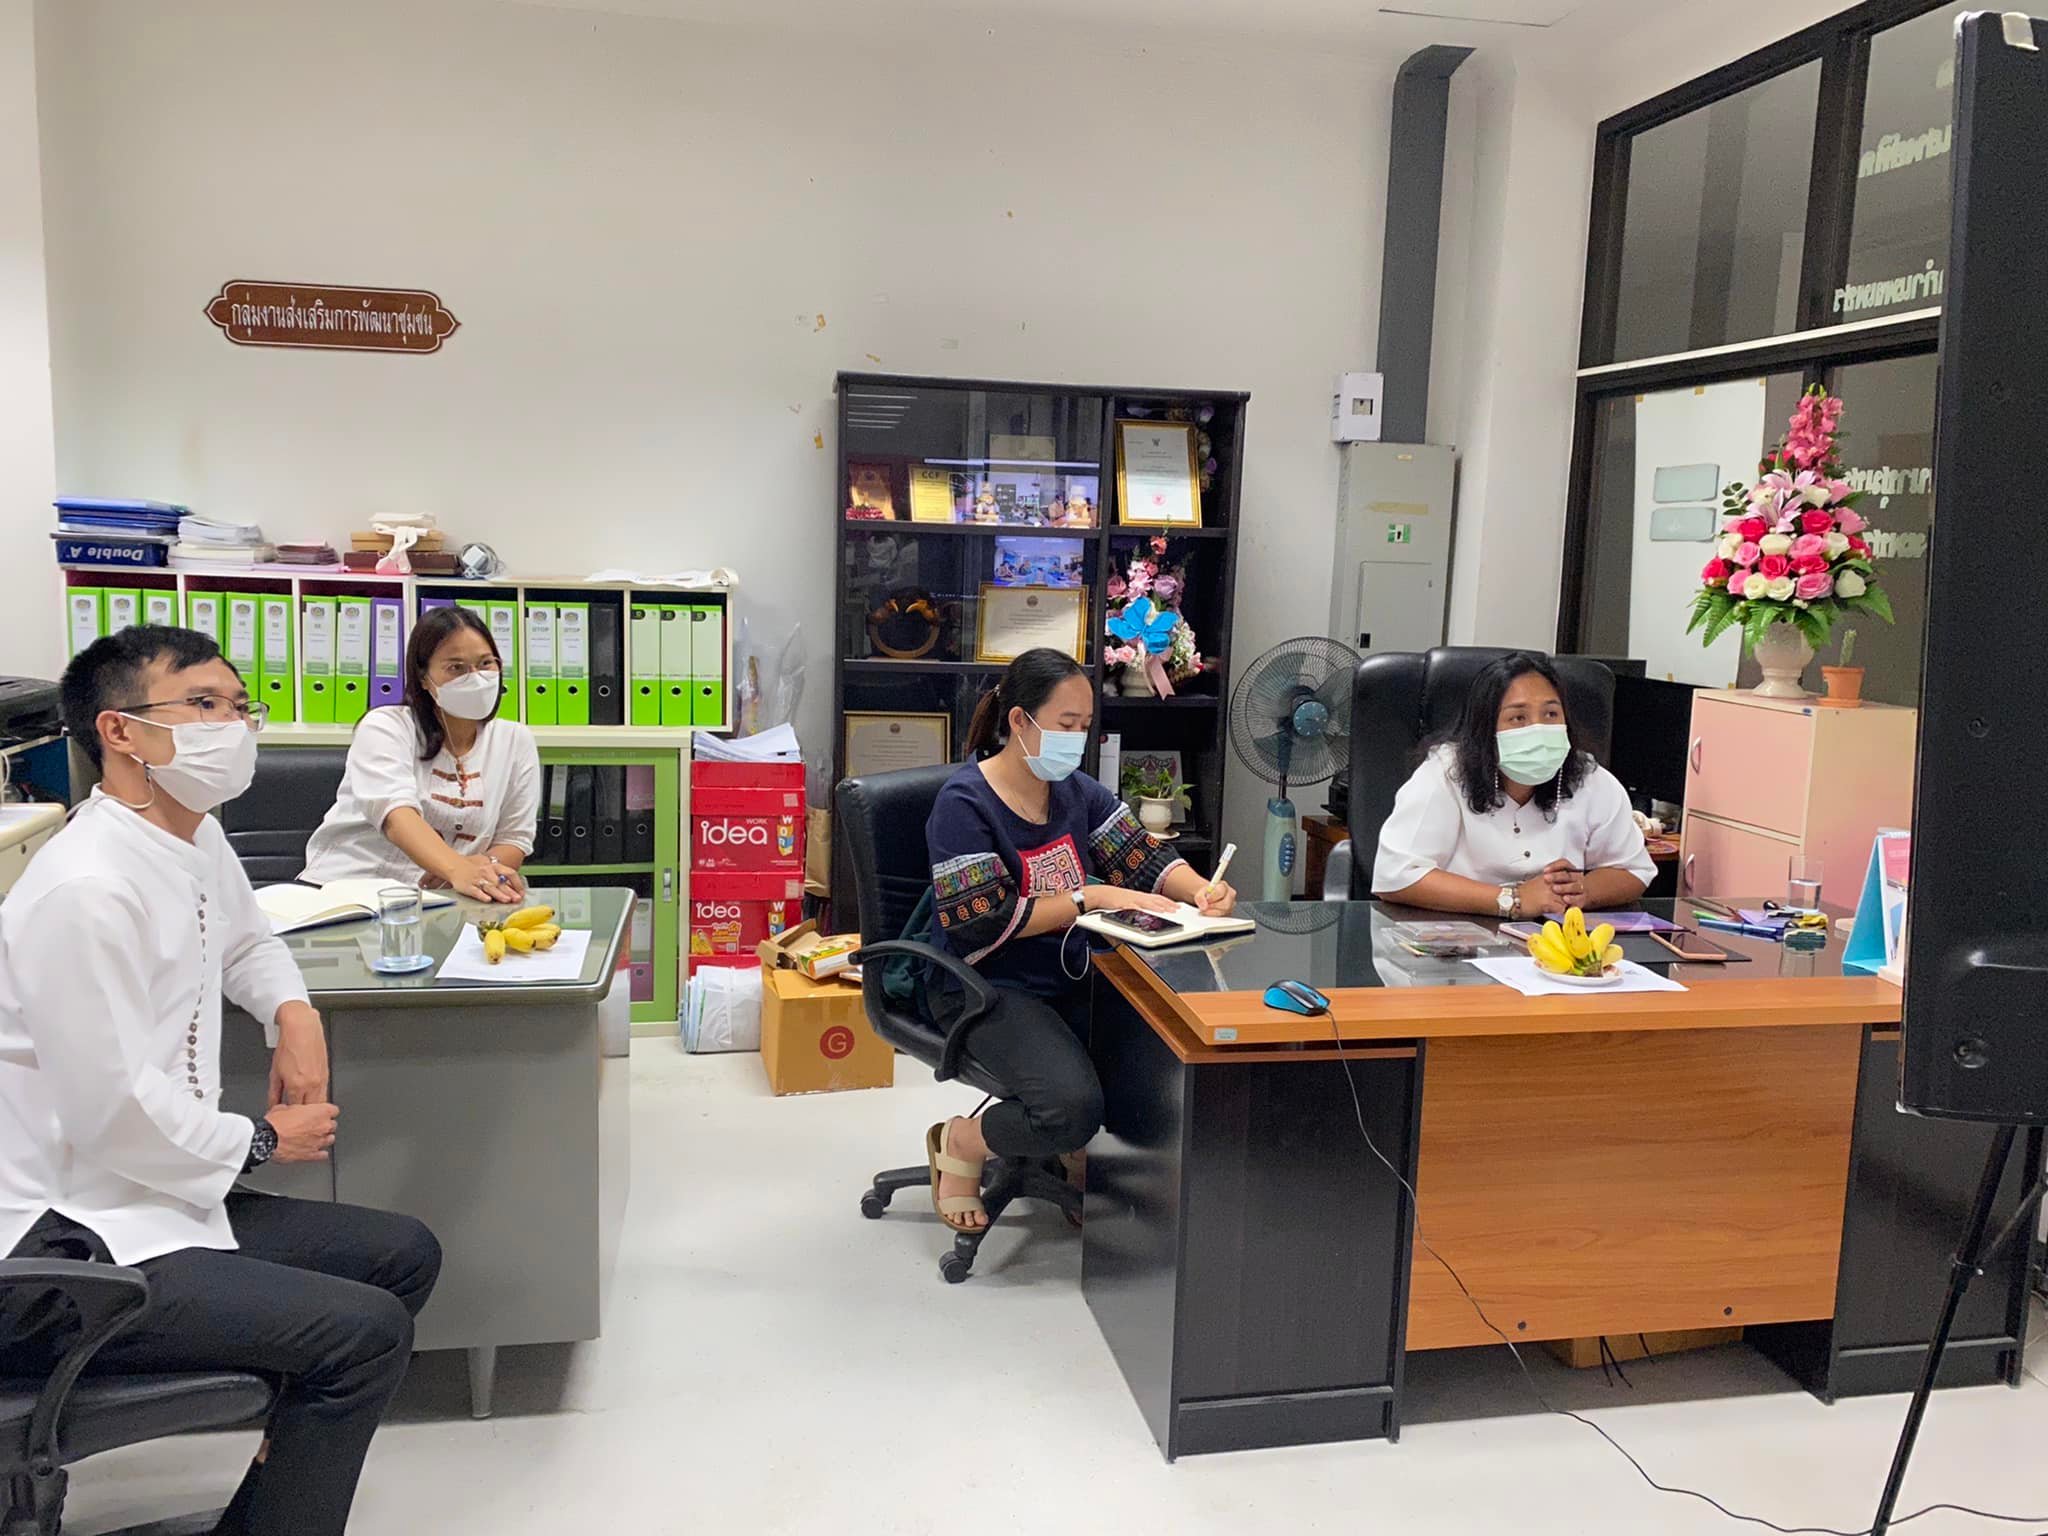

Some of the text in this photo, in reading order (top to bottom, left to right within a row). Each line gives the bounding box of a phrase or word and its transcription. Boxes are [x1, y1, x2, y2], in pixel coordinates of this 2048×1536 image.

[231, 292, 433, 344] กลุ่มงานส่งเสริมการพัฒนาชุมชน
[70, 546, 144, 561] Double A
[701, 818, 767, 845] idea
[696, 901, 740, 919] idea
[828, 1032, 847, 1053] G
